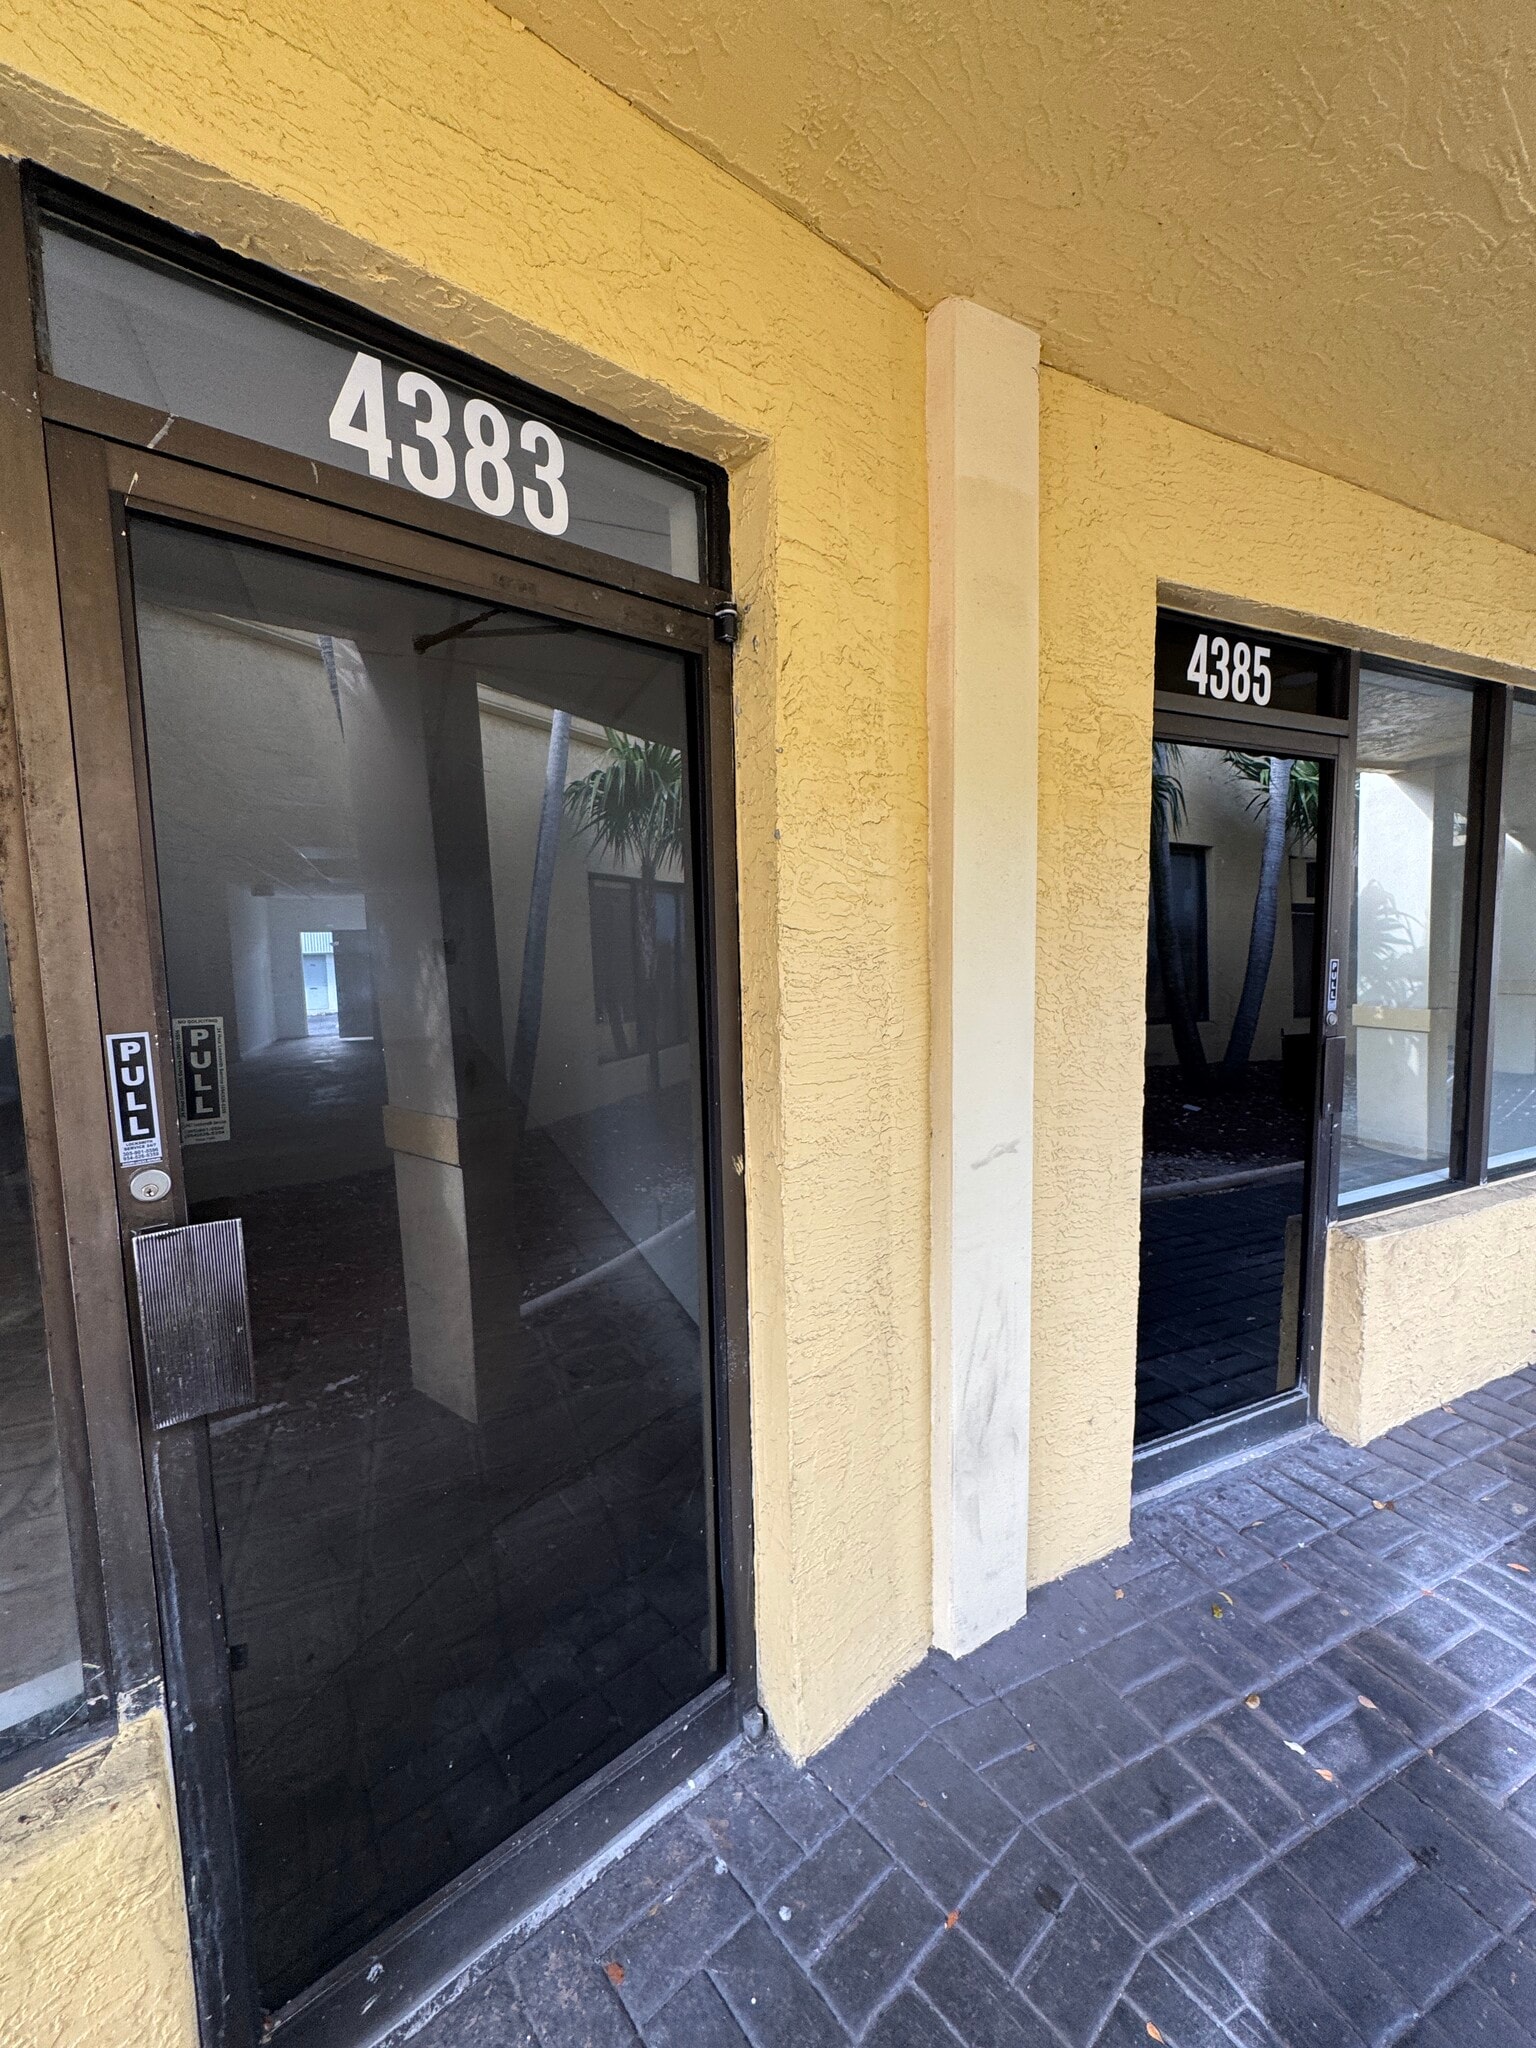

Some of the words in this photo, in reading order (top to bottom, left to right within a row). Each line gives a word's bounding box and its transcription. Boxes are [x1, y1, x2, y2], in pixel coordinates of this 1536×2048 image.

[329, 352, 569, 535] 4383
[1186, 634, 1272, 706] 4385
[119, 1041, 150, 1136] PULL
[190, 1028, 213, 1114] PULL
